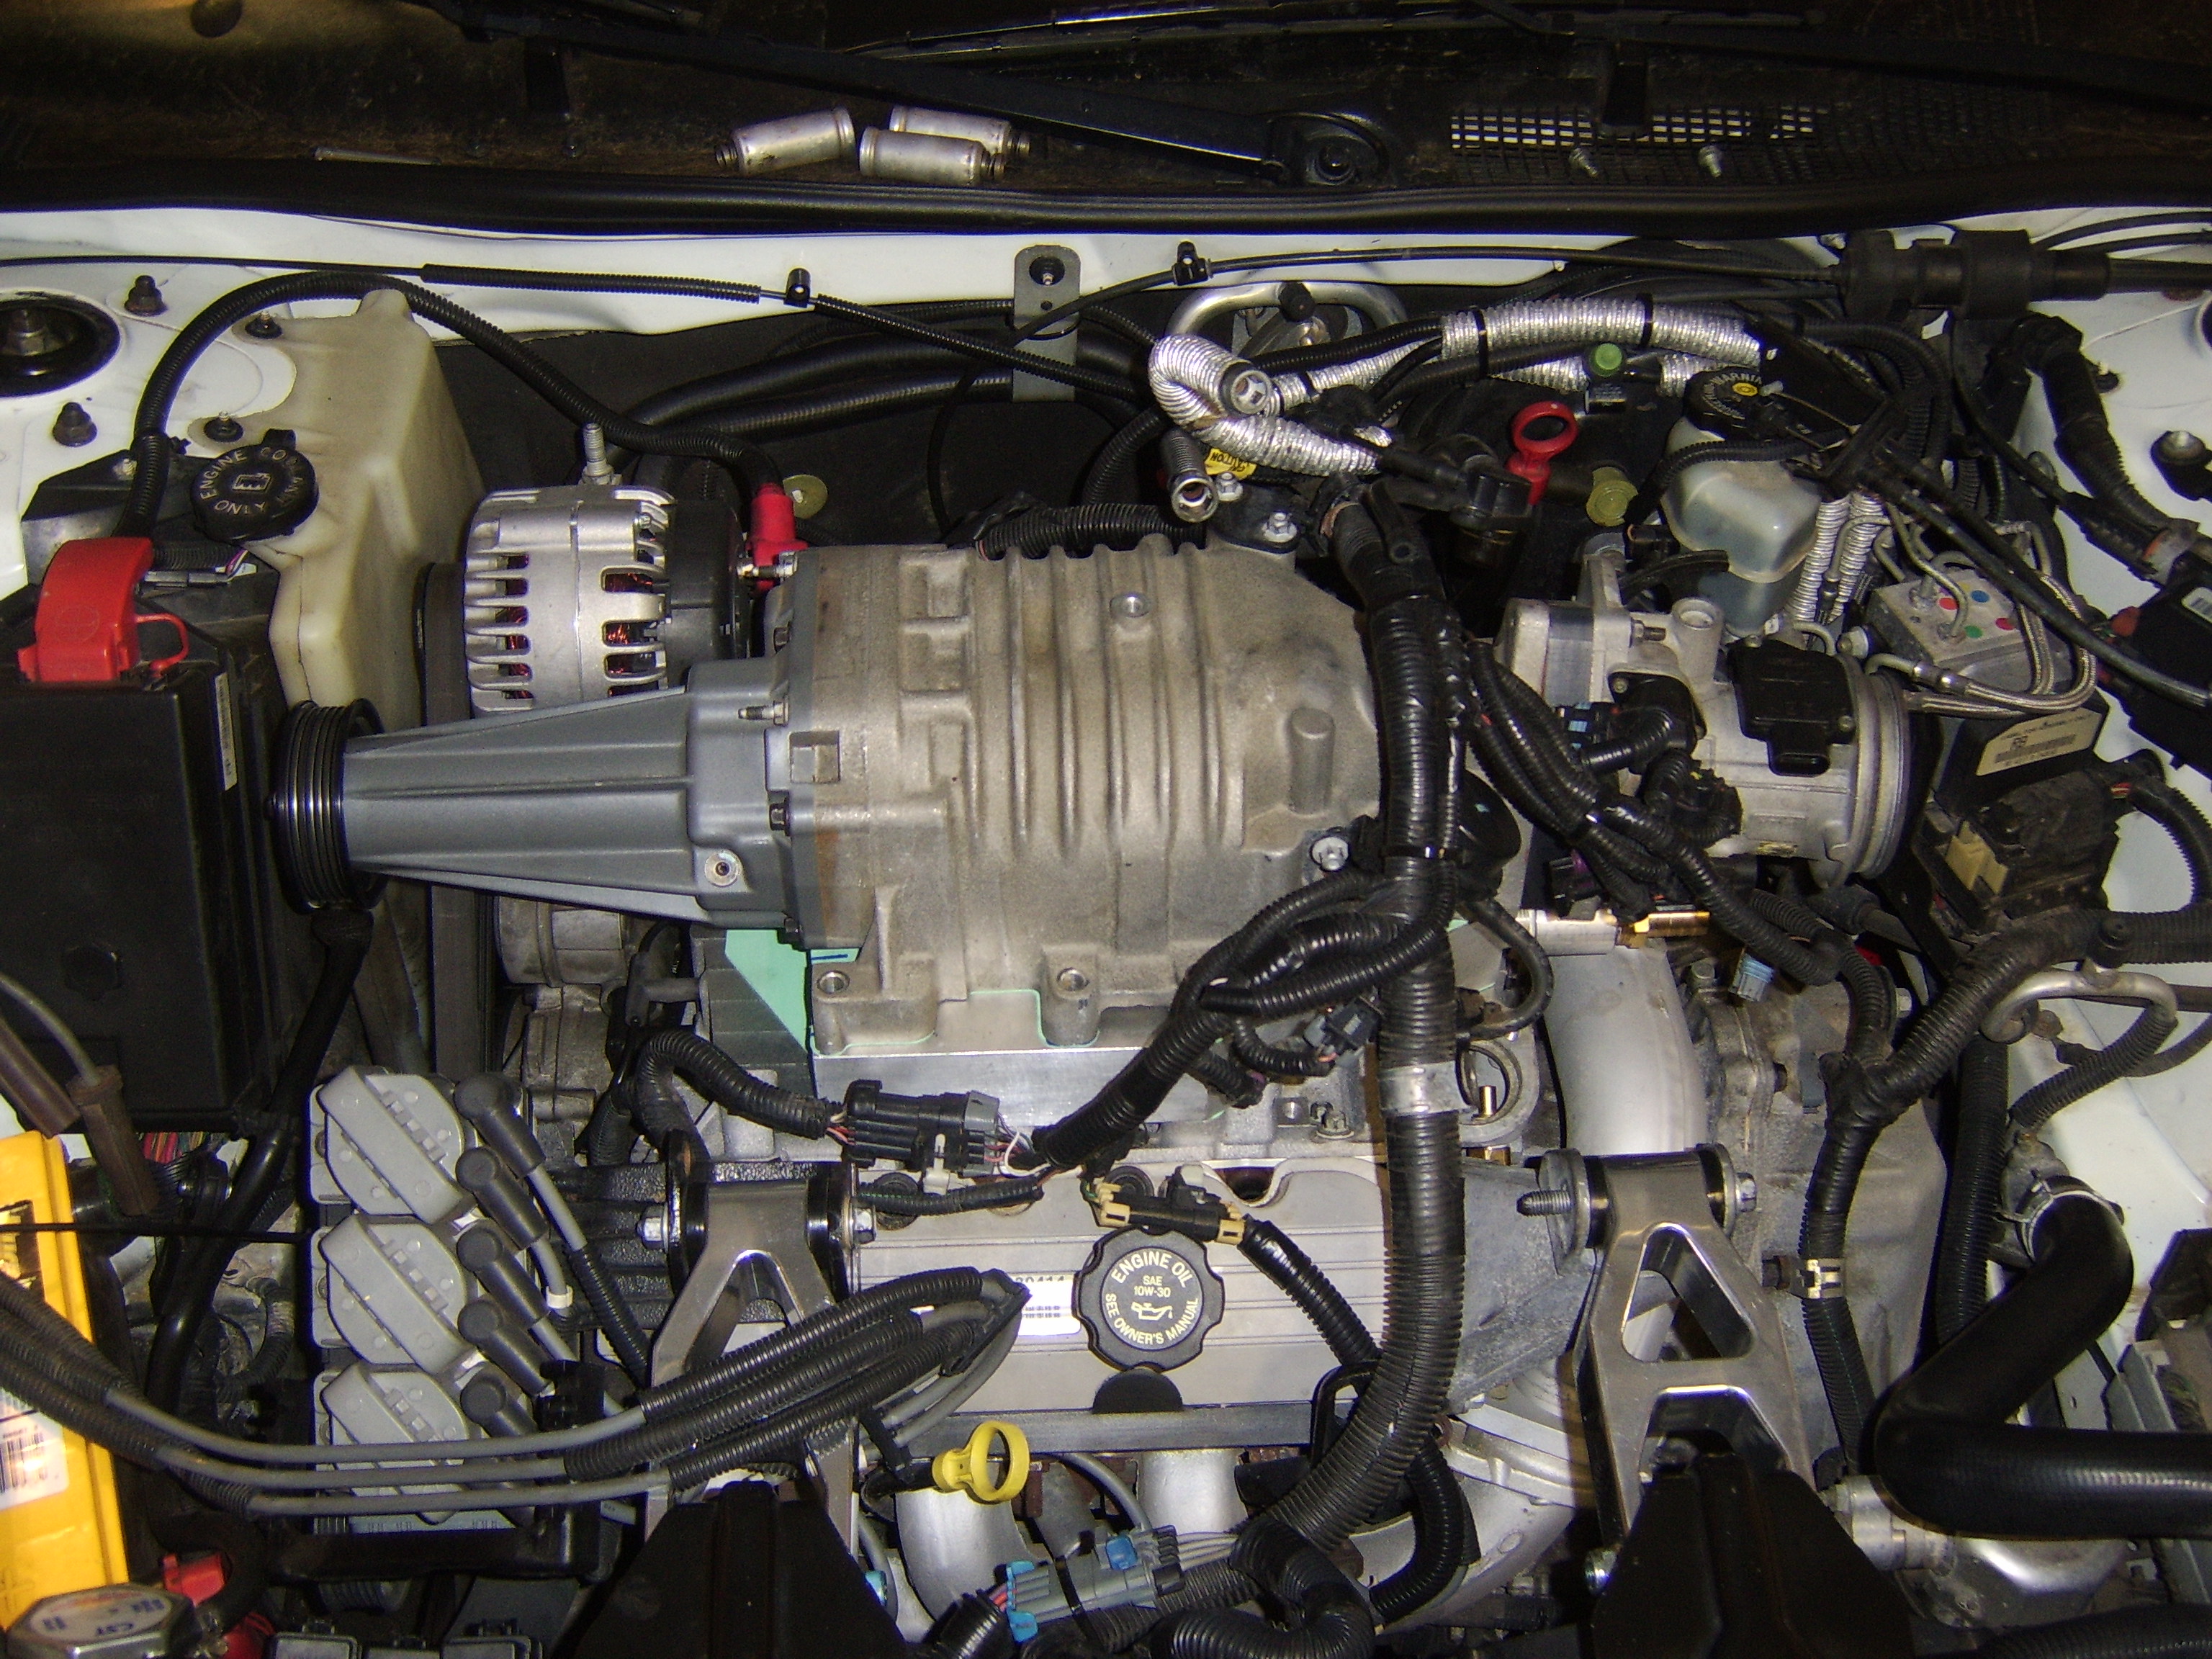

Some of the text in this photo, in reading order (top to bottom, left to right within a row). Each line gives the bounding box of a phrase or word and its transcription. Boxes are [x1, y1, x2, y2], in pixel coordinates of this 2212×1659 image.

[199, 446, 304, 505] ENGINE COOAN
[213, 500, 266, 515] ONLY
[1111, 1251, 1193, 1288] ENGINE OIL
[1143, 1274, 1163, 1286] SAE
[1133, 1285, 1172, 1298] 10W-30
[1105, 1292, 1199, 1345] SEE OWNER'S MANUAL
